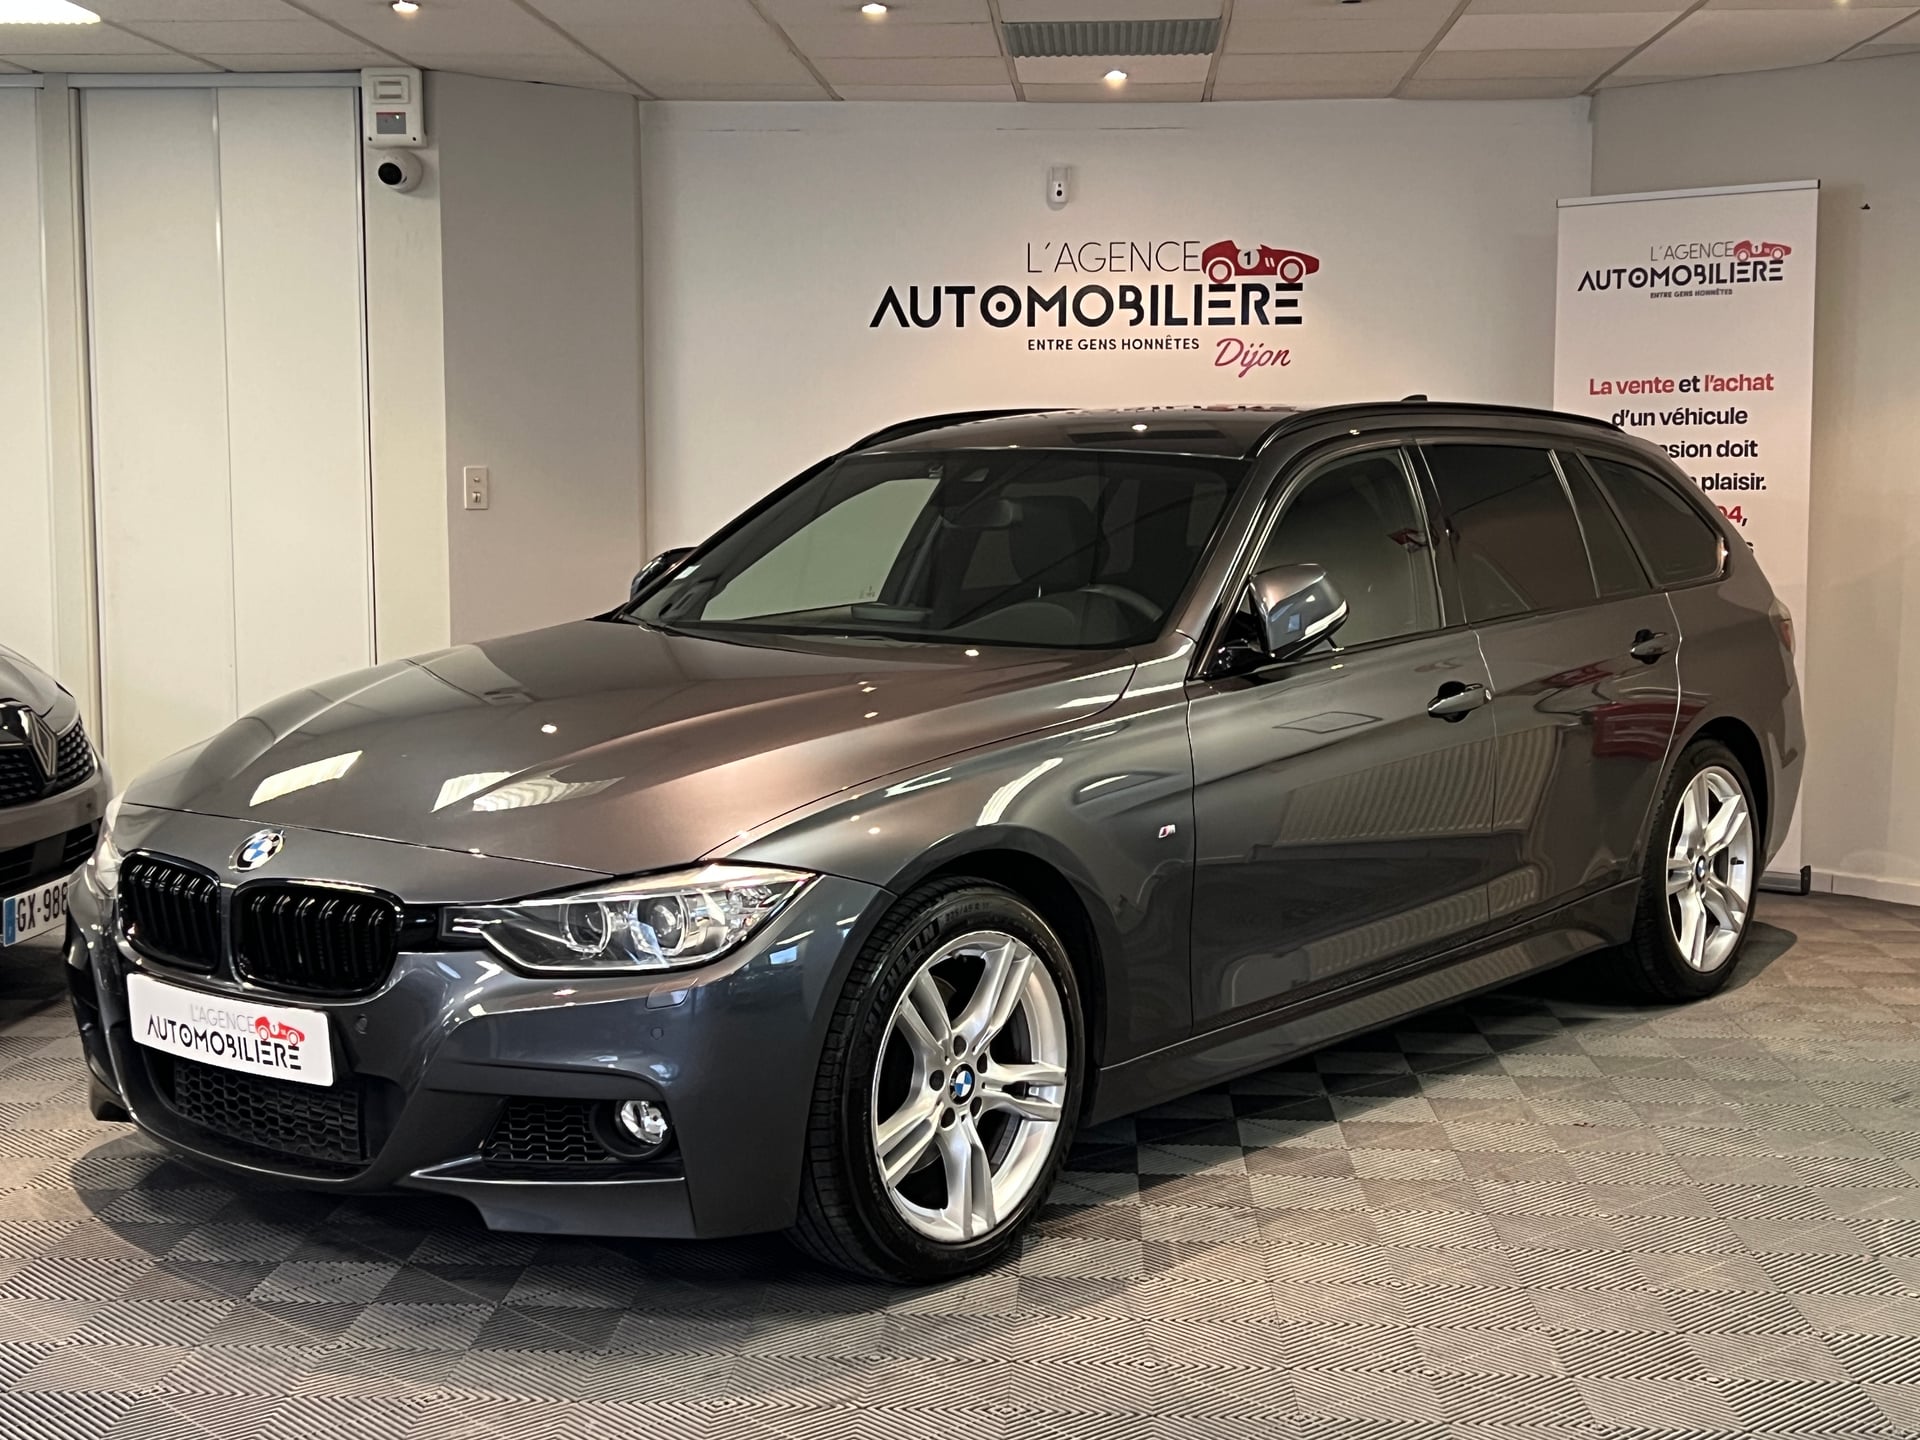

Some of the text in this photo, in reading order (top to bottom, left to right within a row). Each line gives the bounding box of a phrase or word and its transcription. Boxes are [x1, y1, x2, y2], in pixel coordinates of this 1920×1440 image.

[1026, 240, 1201, 273] L'AGENCE
[1243, 250, 1253, 266] 1
[1650, 240, 1735, 262] L'AGENCE
[1027, 333, 1200, 352] ENTRE GENS HONNÊTES
[1213, 337, 1292, 379] Dijon
[1589, 373, 1775, 396] La vente et l'achat
[1611, 407, 1749, 428] d'un véhicule
[1716, 440, 1759, 458] doit
[1701, 472, 1767, 493] plaisir.
[189, 1003, 256, 1034] L'AGENCE
